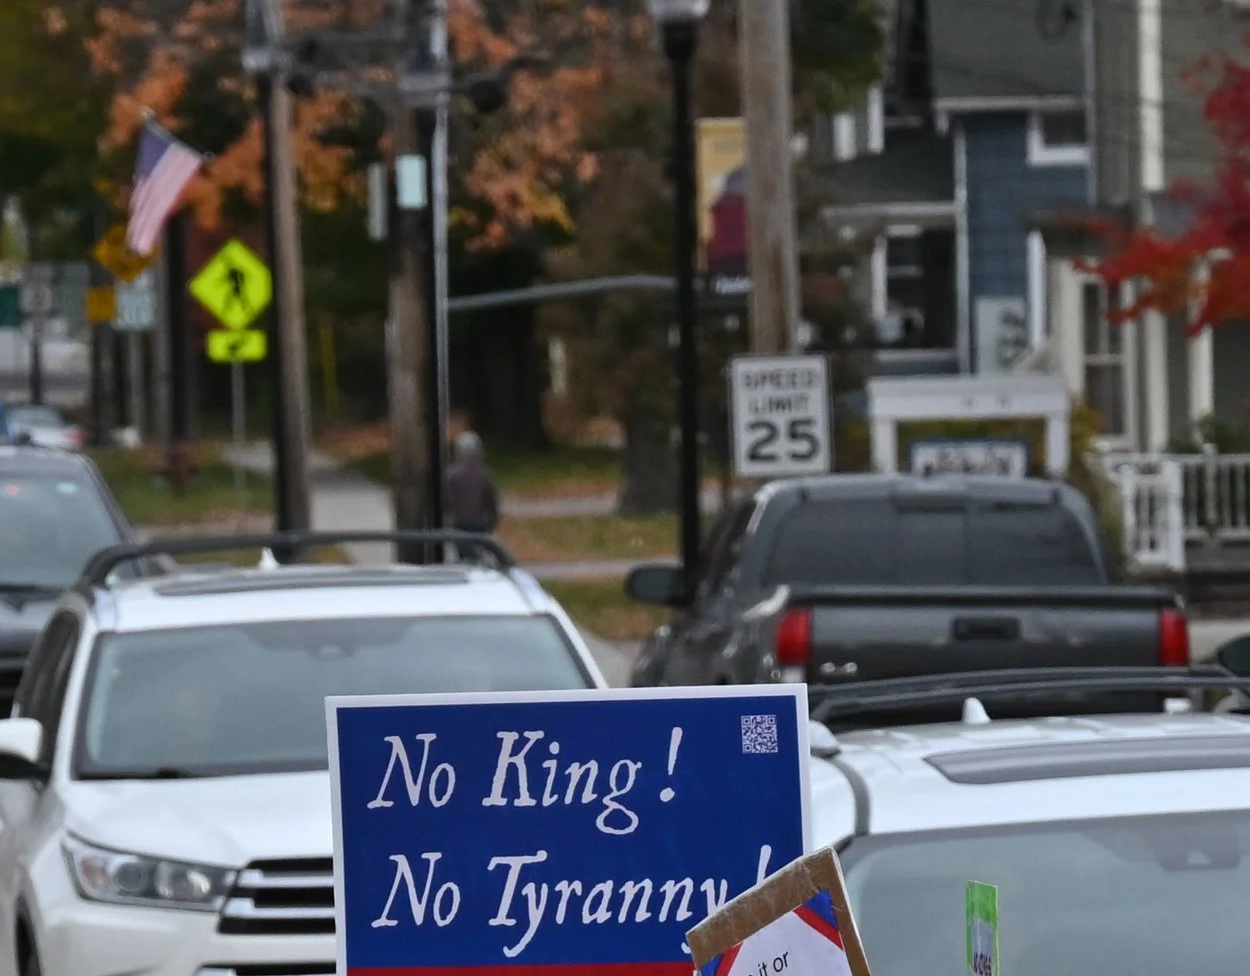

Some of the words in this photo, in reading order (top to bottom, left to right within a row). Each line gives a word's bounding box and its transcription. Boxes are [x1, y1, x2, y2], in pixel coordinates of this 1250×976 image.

[742, 367, 817, 390] SPEED
[748, 396, 809, 414] LIMIT
[745, 418, 820, 462] 25
[367, 733, 456, 809] No
[372, 852, 461, 928] No
[773, 951, 789, 972] or
